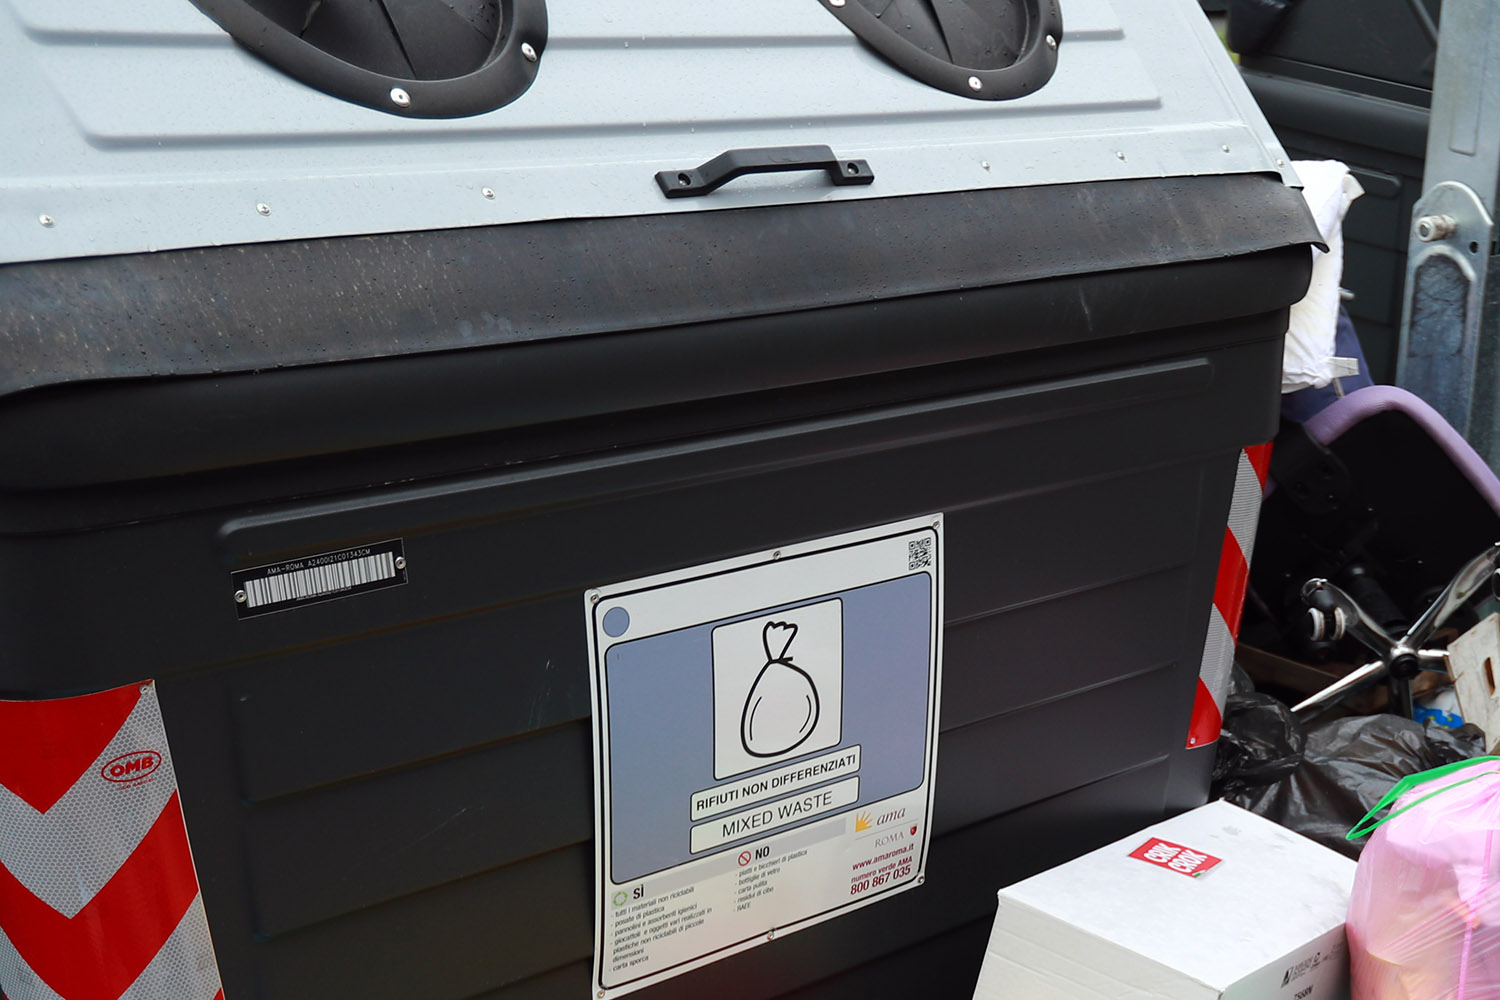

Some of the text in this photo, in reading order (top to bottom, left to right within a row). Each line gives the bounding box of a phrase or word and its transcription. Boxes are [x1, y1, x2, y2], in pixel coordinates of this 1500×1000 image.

[266, 562, 304, 575] AMA-ROMA
[110, 756, 153, 777] OMB
[696, 754, 856, 811] RIFIUTI NON DIFFERENZIATI
[722, 791, 833, 838] MIXED WASTE
[876, 807, 906, 826] ama
[875, 831, 905, 848] ROMA
[755, 845, 770, 860] NO
[852, 843, 914, 871] www.amaroma.it
[1143, 842, 1182, 863] CRIK
[1167, 849, 1208, 873] CROK
[850, 864, 911, 895] 800 867 035
[851, 856, 913, 883] numero verde AMA
[633, 884, 644, 900] SÌ
